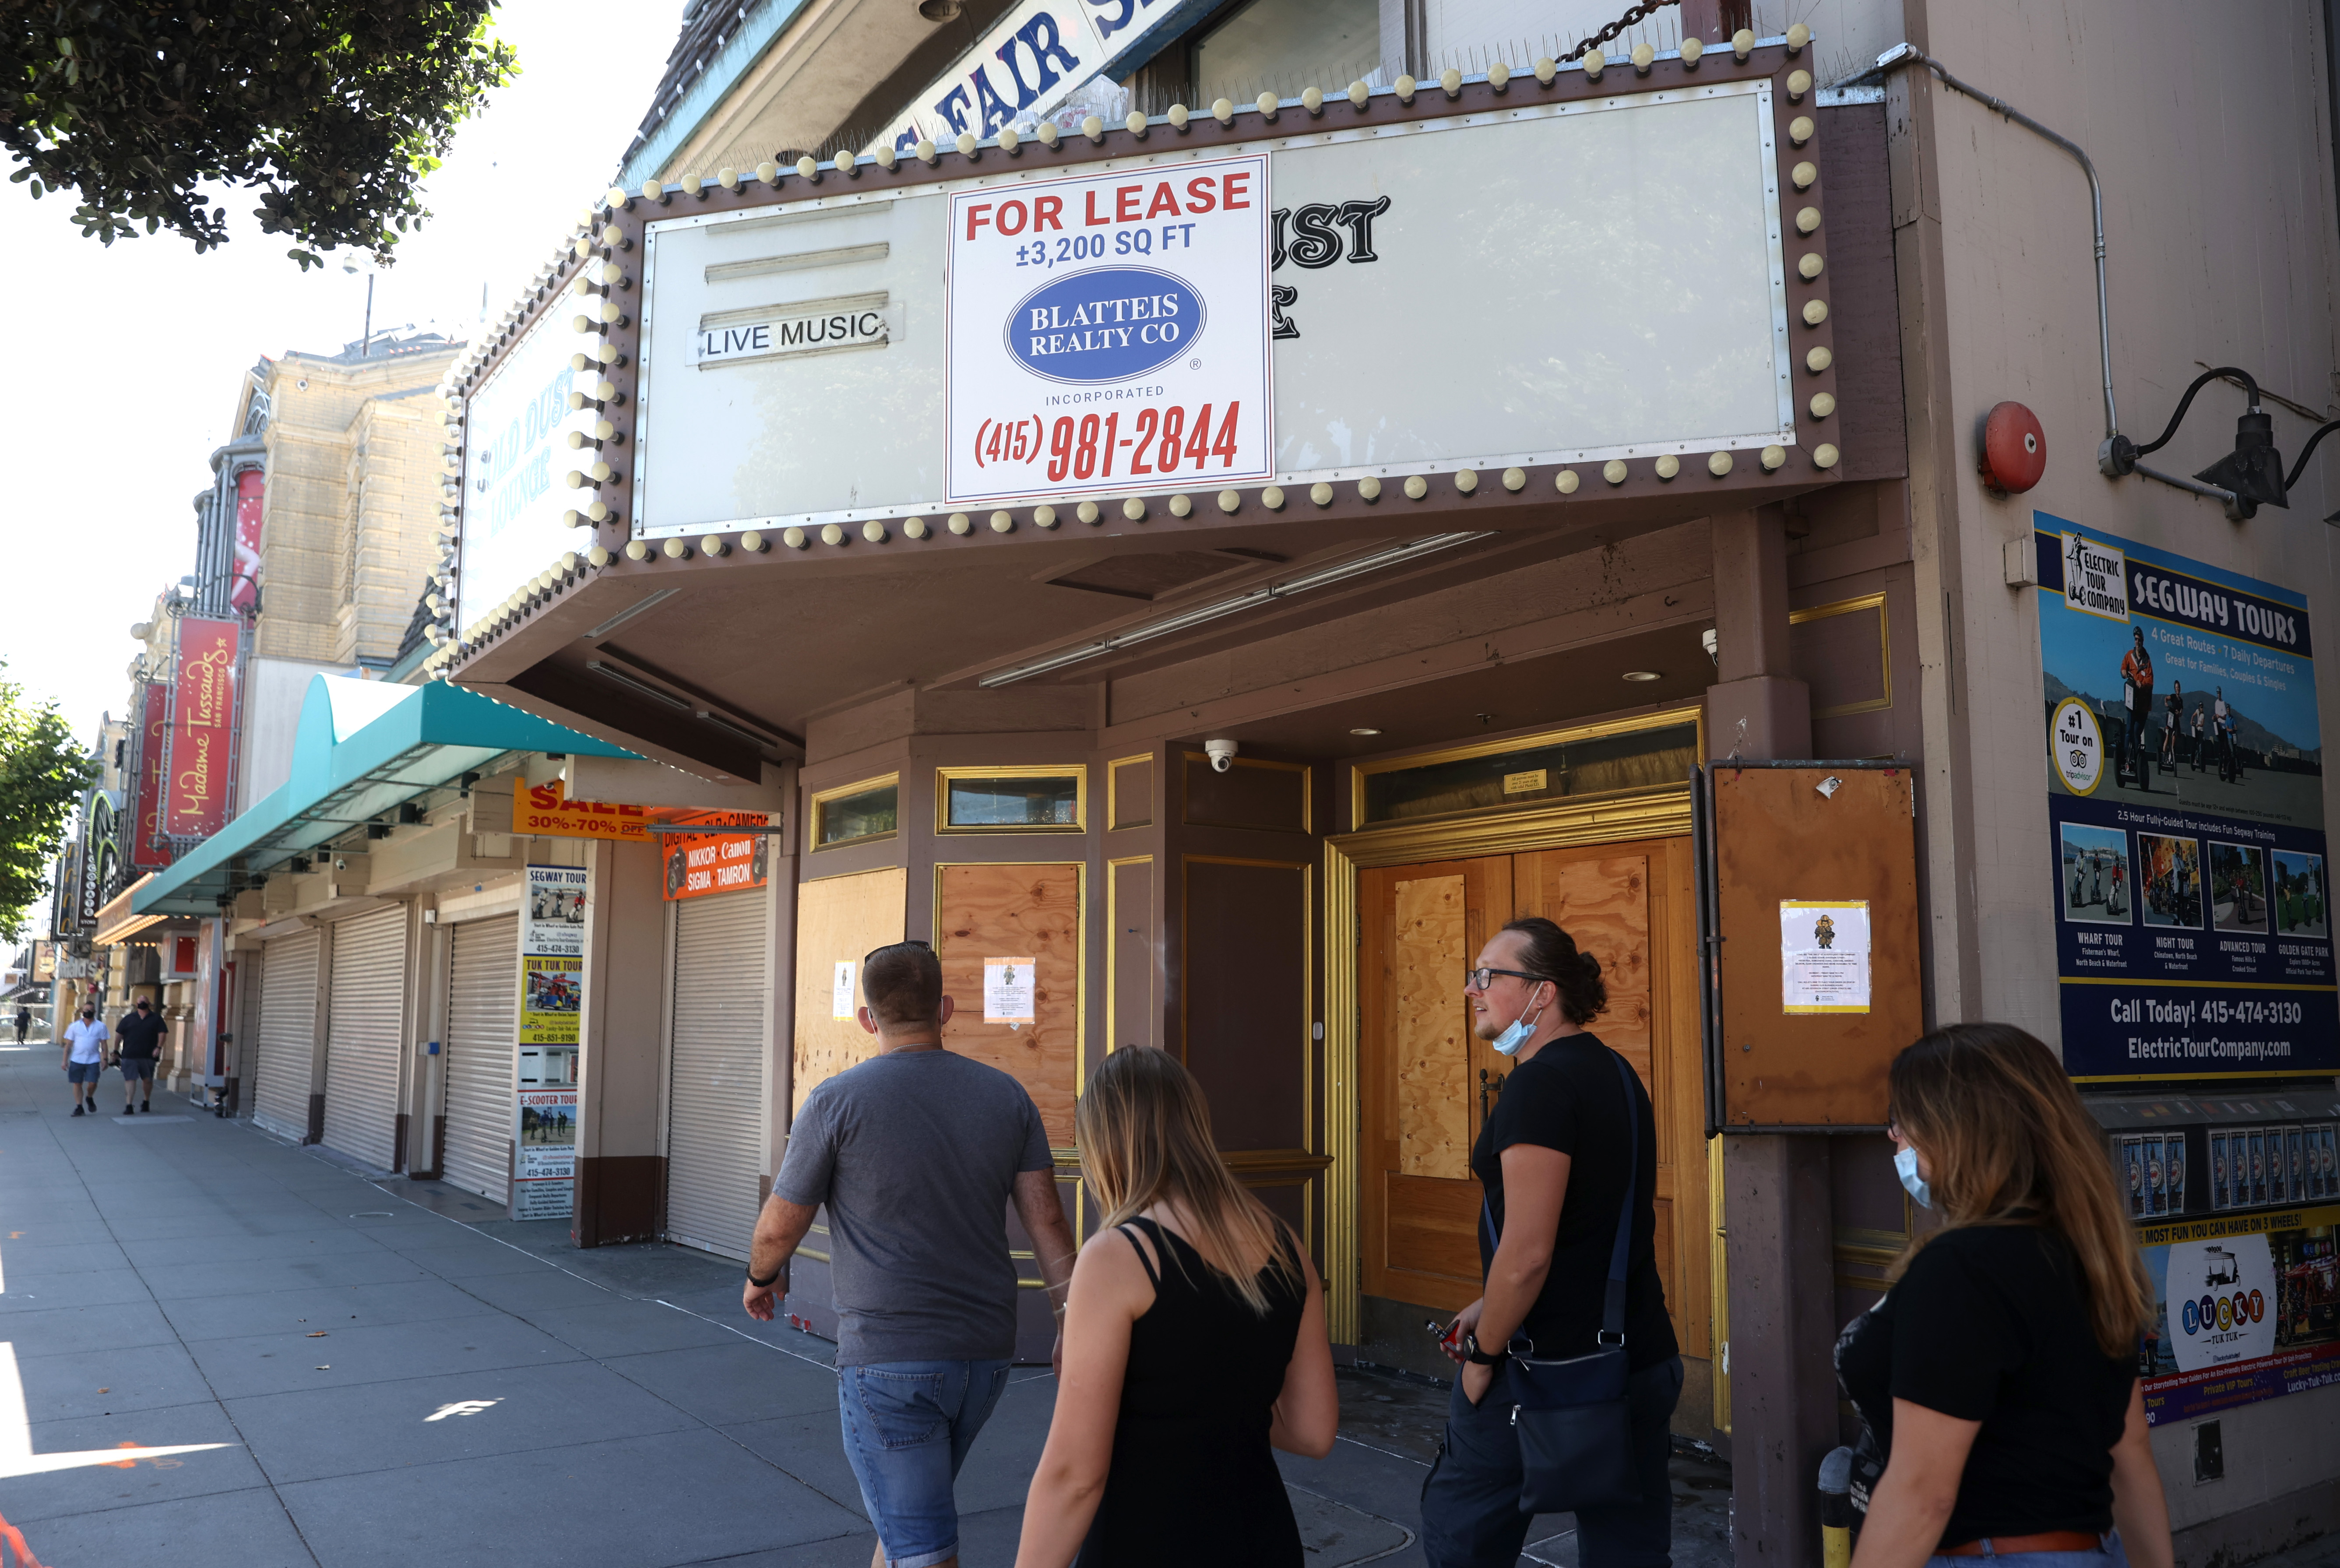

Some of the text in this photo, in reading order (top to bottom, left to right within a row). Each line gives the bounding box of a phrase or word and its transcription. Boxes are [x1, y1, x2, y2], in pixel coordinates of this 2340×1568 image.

[934, 12, 1079, 139] FAIR
[967, 172, 1250, 241] FOR LEASE
[1016, 223, 1196, 268] ±3,200 SQ FT
[1030, 293, 1179, 331] BLATTEIS
[707, 313, 879, 355] LIVE MUSIC
[1030, 322, 1179, 356] REALTY CO
[1046, 386, 1164, 406] INCORPORATED
[524, 363, 575, 455] DUST
[975, 401, 1239, 482] (415) 981-2844
[490, 445, 551, 538] LOUNGE
[2084, 552, 2119, 578] ELECTRIC
[2086, 571, 2106, 592] TOUR
[2087, 590, 2125, 615] COMPANY
[2134, 572, 2297, 646] SEGWAY TOURS
[2151, 627, 2295, 675] 4 Great Routes 7 Daily Departures
[2165, 653, 2286, 692] Great for Families, Couples & Singles
[216, 667, 225, 710] FRANCISCO
[2068, 710, 2082, 729] #1
[2060, 729, 2093, 748] Tour on
[2066, 770, 2092, 781] tripadvisor
[528, 816, 645, 834] 30%-70% OFF
[2118, 810, 2276, 842] 2.5 Hour Fully-Guided Tour includes Fun Segway Training
[689, 840, 751, 868] NIKKOR Canon
[530, 870, 587, 884] SEGWAY TOUR
[688, 863, 750, 891] SIGMA TAMRON
[537, 944, 580, 954] 415-474-3130
[2077, 932, 2123, 946] WHARF TOUR
[2156, 936, 2194, 949] NIGHT TOUR
[2220, 940, 2266, 953] ADVANCED TOUR
[2082, 948, 2120, 957] Fisherman's Wharf,
[2154, 951, 2174, 960] Chinatown,
[2279, 944, 2329, 957] GOLDEN GATE PARK
[527, 960, 542, 970] TUK
[545, 960, 560, 970] TUK
[2106, 960, 2127, 968] Waterfront
[2168, 962, 2189, 970] Waterfront
[2111, 998, 2301, 1028] Call Today! 415-474-3130
[533, 1034, 576, 1043] 415-851-9190
[2128, 1037, 2291, 1062] ElectricTourCompany.com
[521, 1095, 559, 1106] E-SCOOTER
[527, 1167, 570, 1178] 415-474-3130
[2146, 1228, 2169, 1244] MOST
[2172, 1226, 2189, 1240] FUN
[2192, 1223, 2207, 1238] YOU
[2209, 1220, 2226, 1236] CAN
[2228, 1218, 2249, 1234] HAVE
[2251, 1217, 2262, 1231] ON
[2264, 1217, 2269, 1230] 3
[2270, 1213, 2302, 1228] WHEELS!
[2185, 1293, 2263, 1332] LUCKY
[2212, 1332, 2238, 1345] TUK TUK
[2153, 1379, 2178, 1390] Storytelling
[2189, 1375, 2202, 1383] Guides
[2217, 1366, 2241, 1378] Eco-Friendly
[2241, 1363, 2256, 1372] Electric
[2256, 1360, 2273, 1370] Powered
[2274, 1358, 2283, 1366] Tour
[2295, 1352, 2312, 1361] Francisco
[2283, 1368, 2297, 1379] Craft
[2203, 1378, 2253, 1396] Private VIP Tours
[2147, 1397, 2164, 1408] Tours
